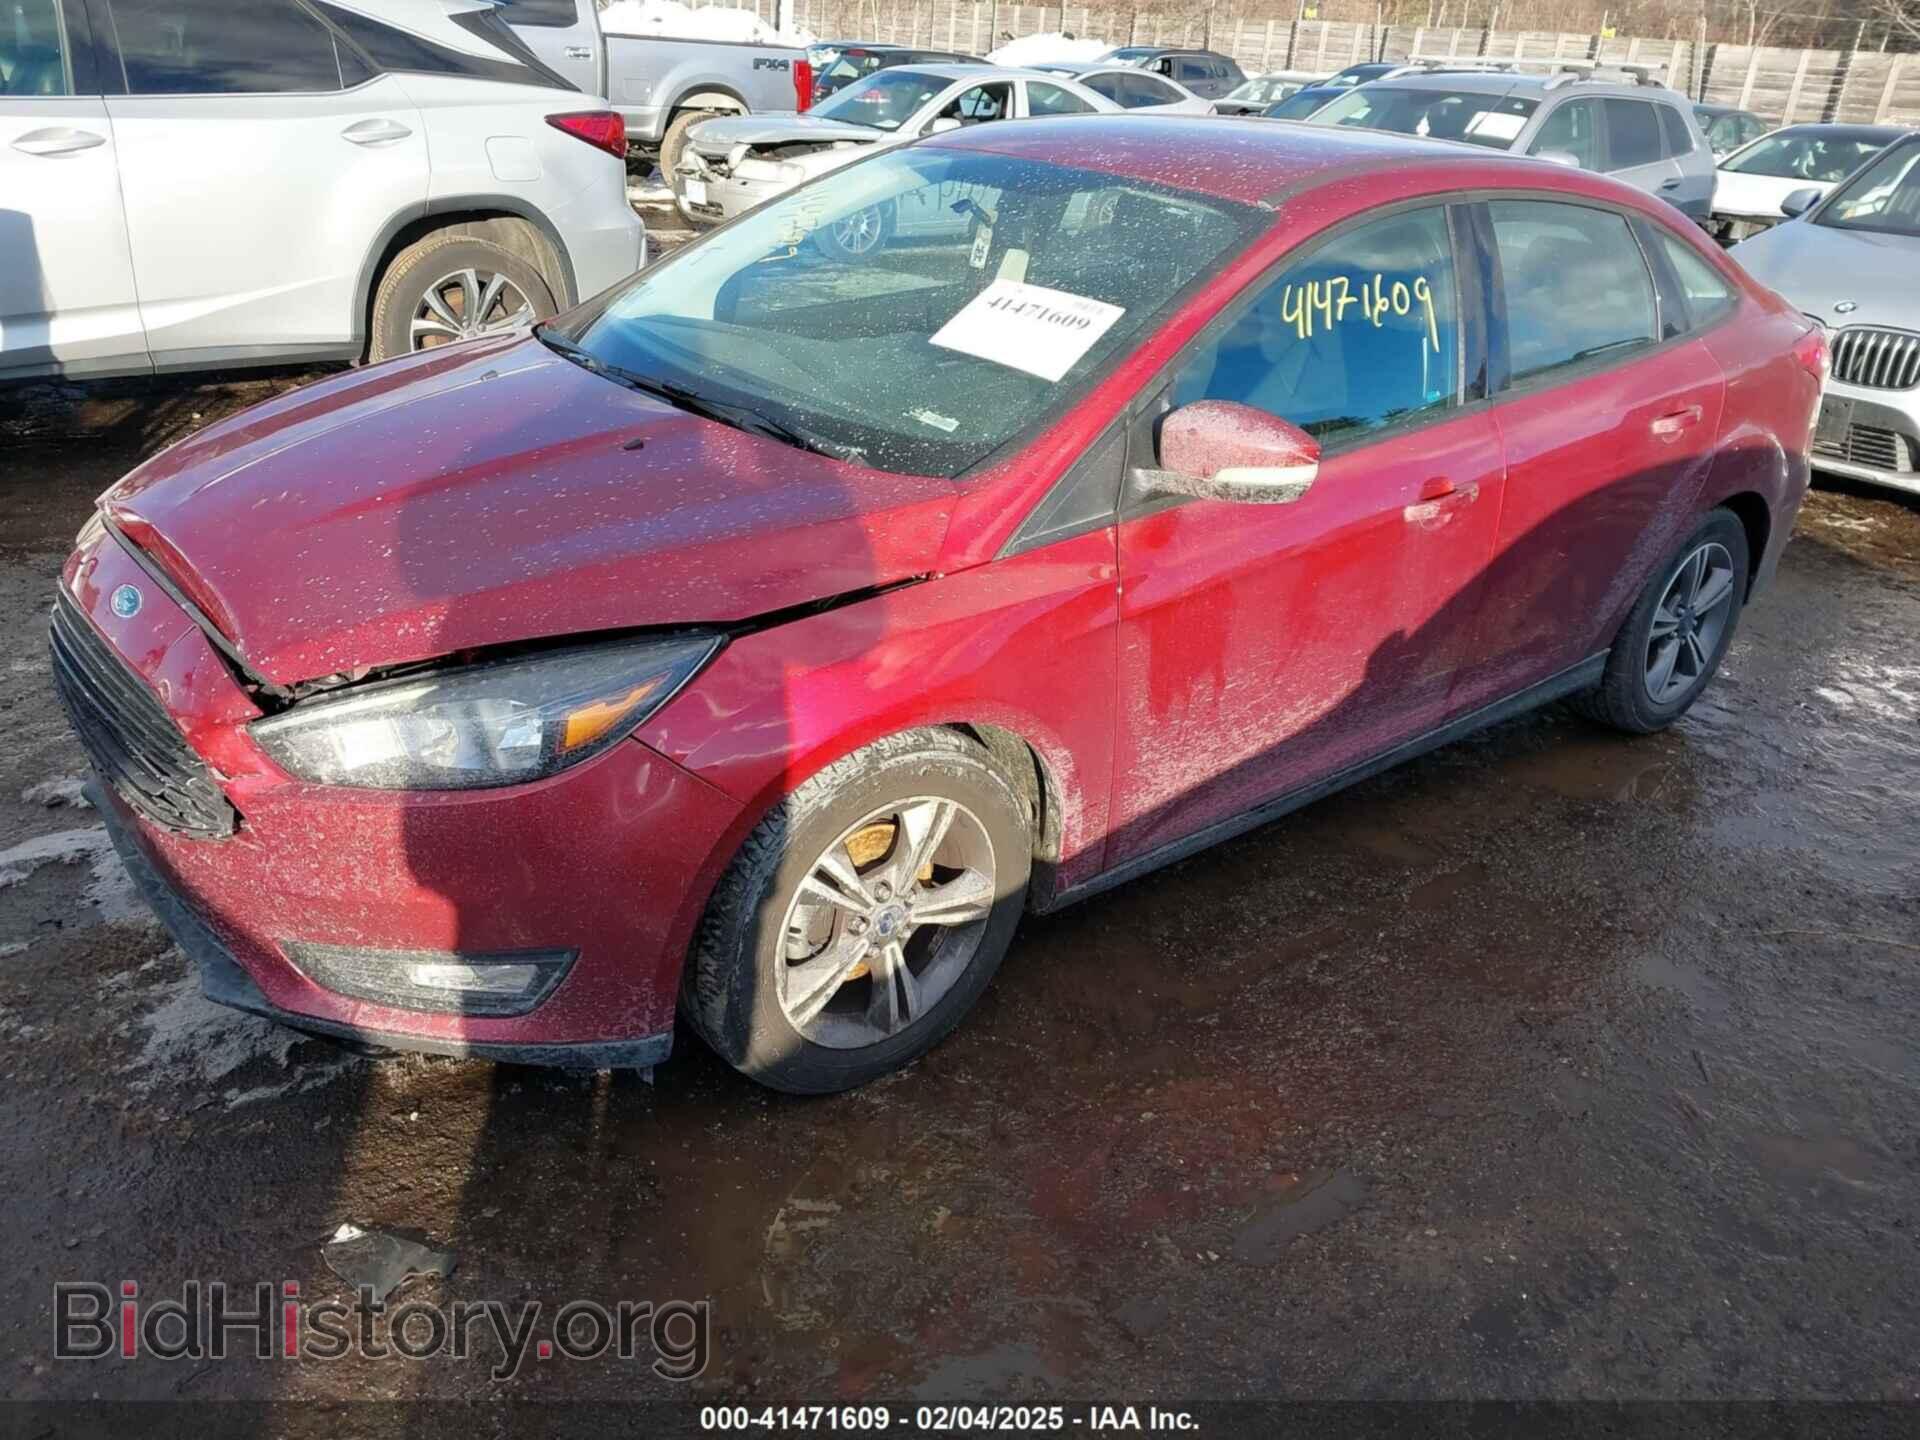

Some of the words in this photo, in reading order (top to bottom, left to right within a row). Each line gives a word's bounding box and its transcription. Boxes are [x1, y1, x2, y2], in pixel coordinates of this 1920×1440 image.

[753, 58, 789, 71] FX4
[987, 296, 1091, 331] 41471609
[1282, 273, 1440, 353] 41471609
